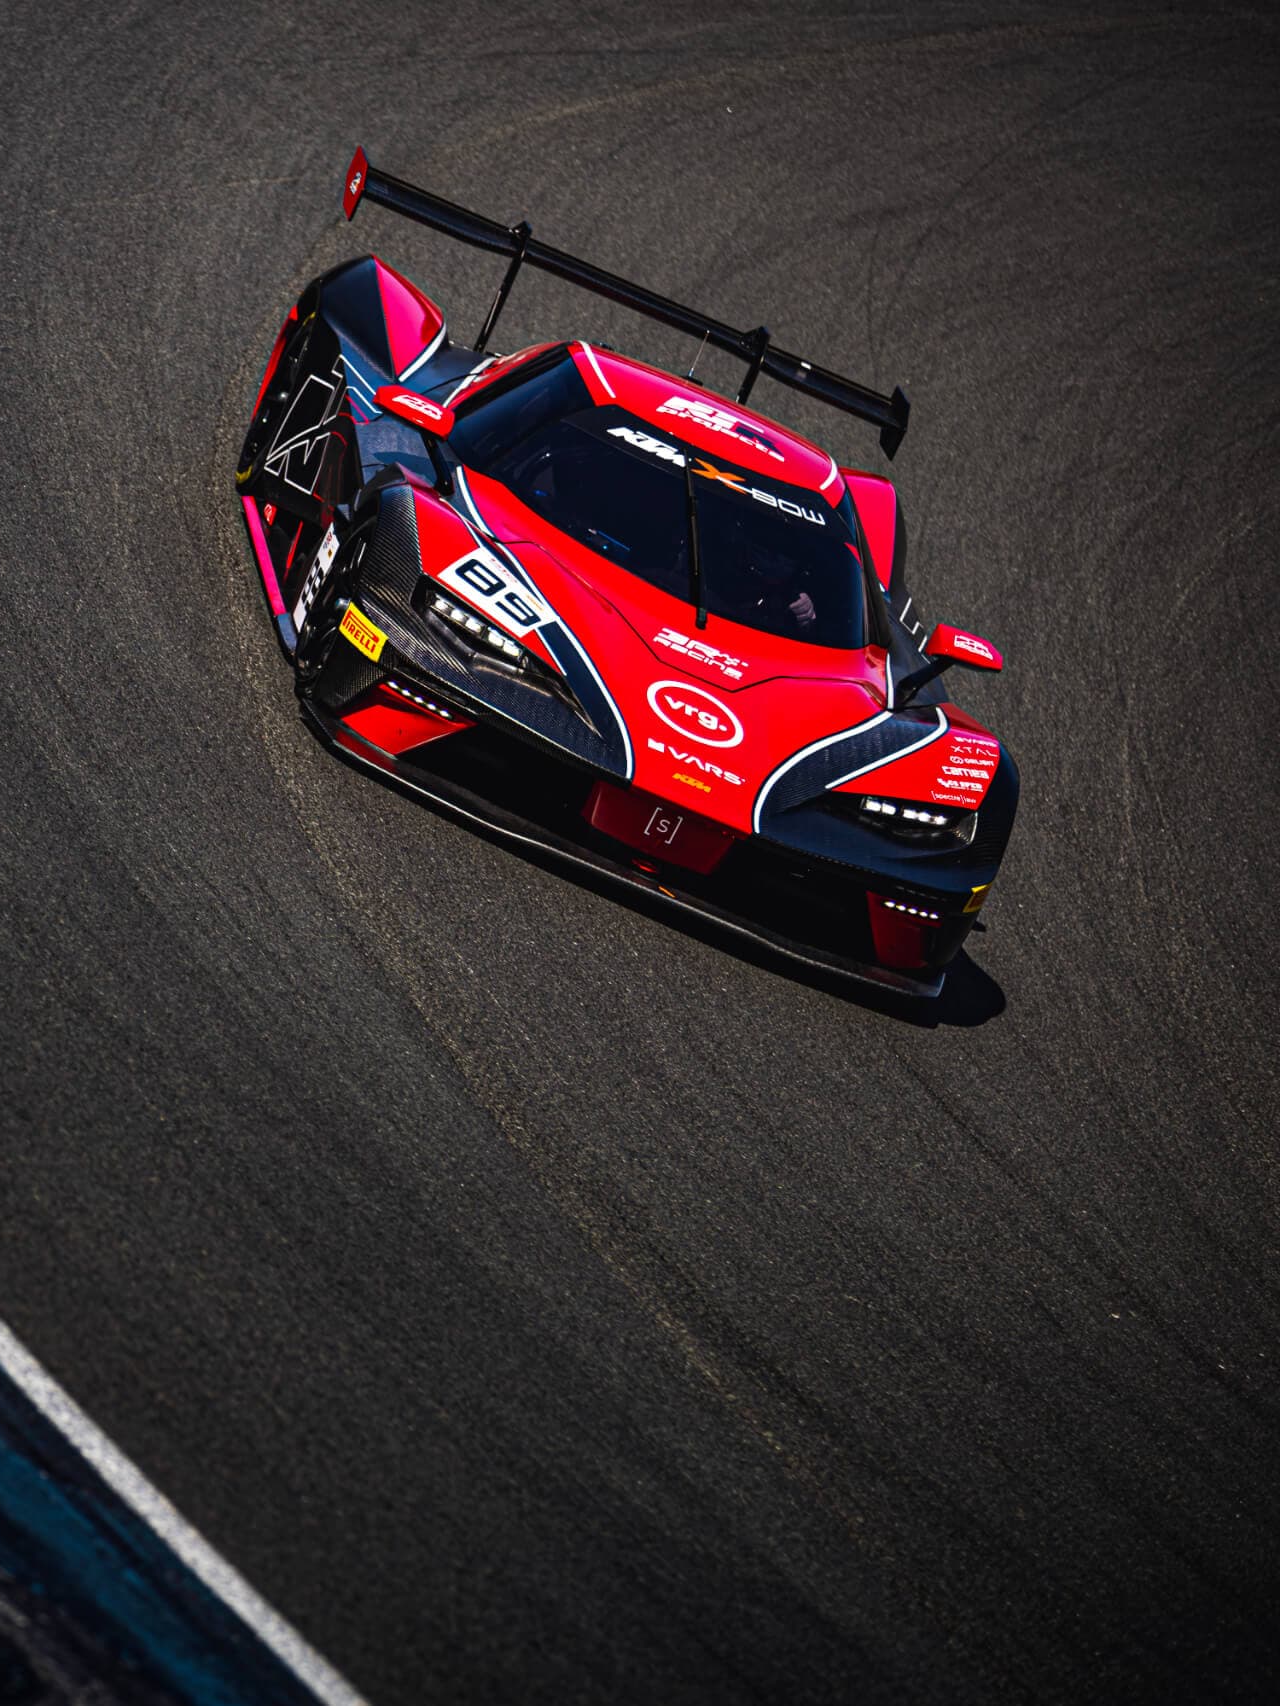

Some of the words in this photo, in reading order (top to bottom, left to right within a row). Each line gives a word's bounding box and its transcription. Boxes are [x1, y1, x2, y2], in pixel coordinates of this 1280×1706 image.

[606, 427, 686, 467] KTM
[691, 457, 826, 526] X-BOW
[455, 559, 542, 627] 89
[342, 610, 380, 653] PIRELLI
[672, 773, 712, 793] KTM
